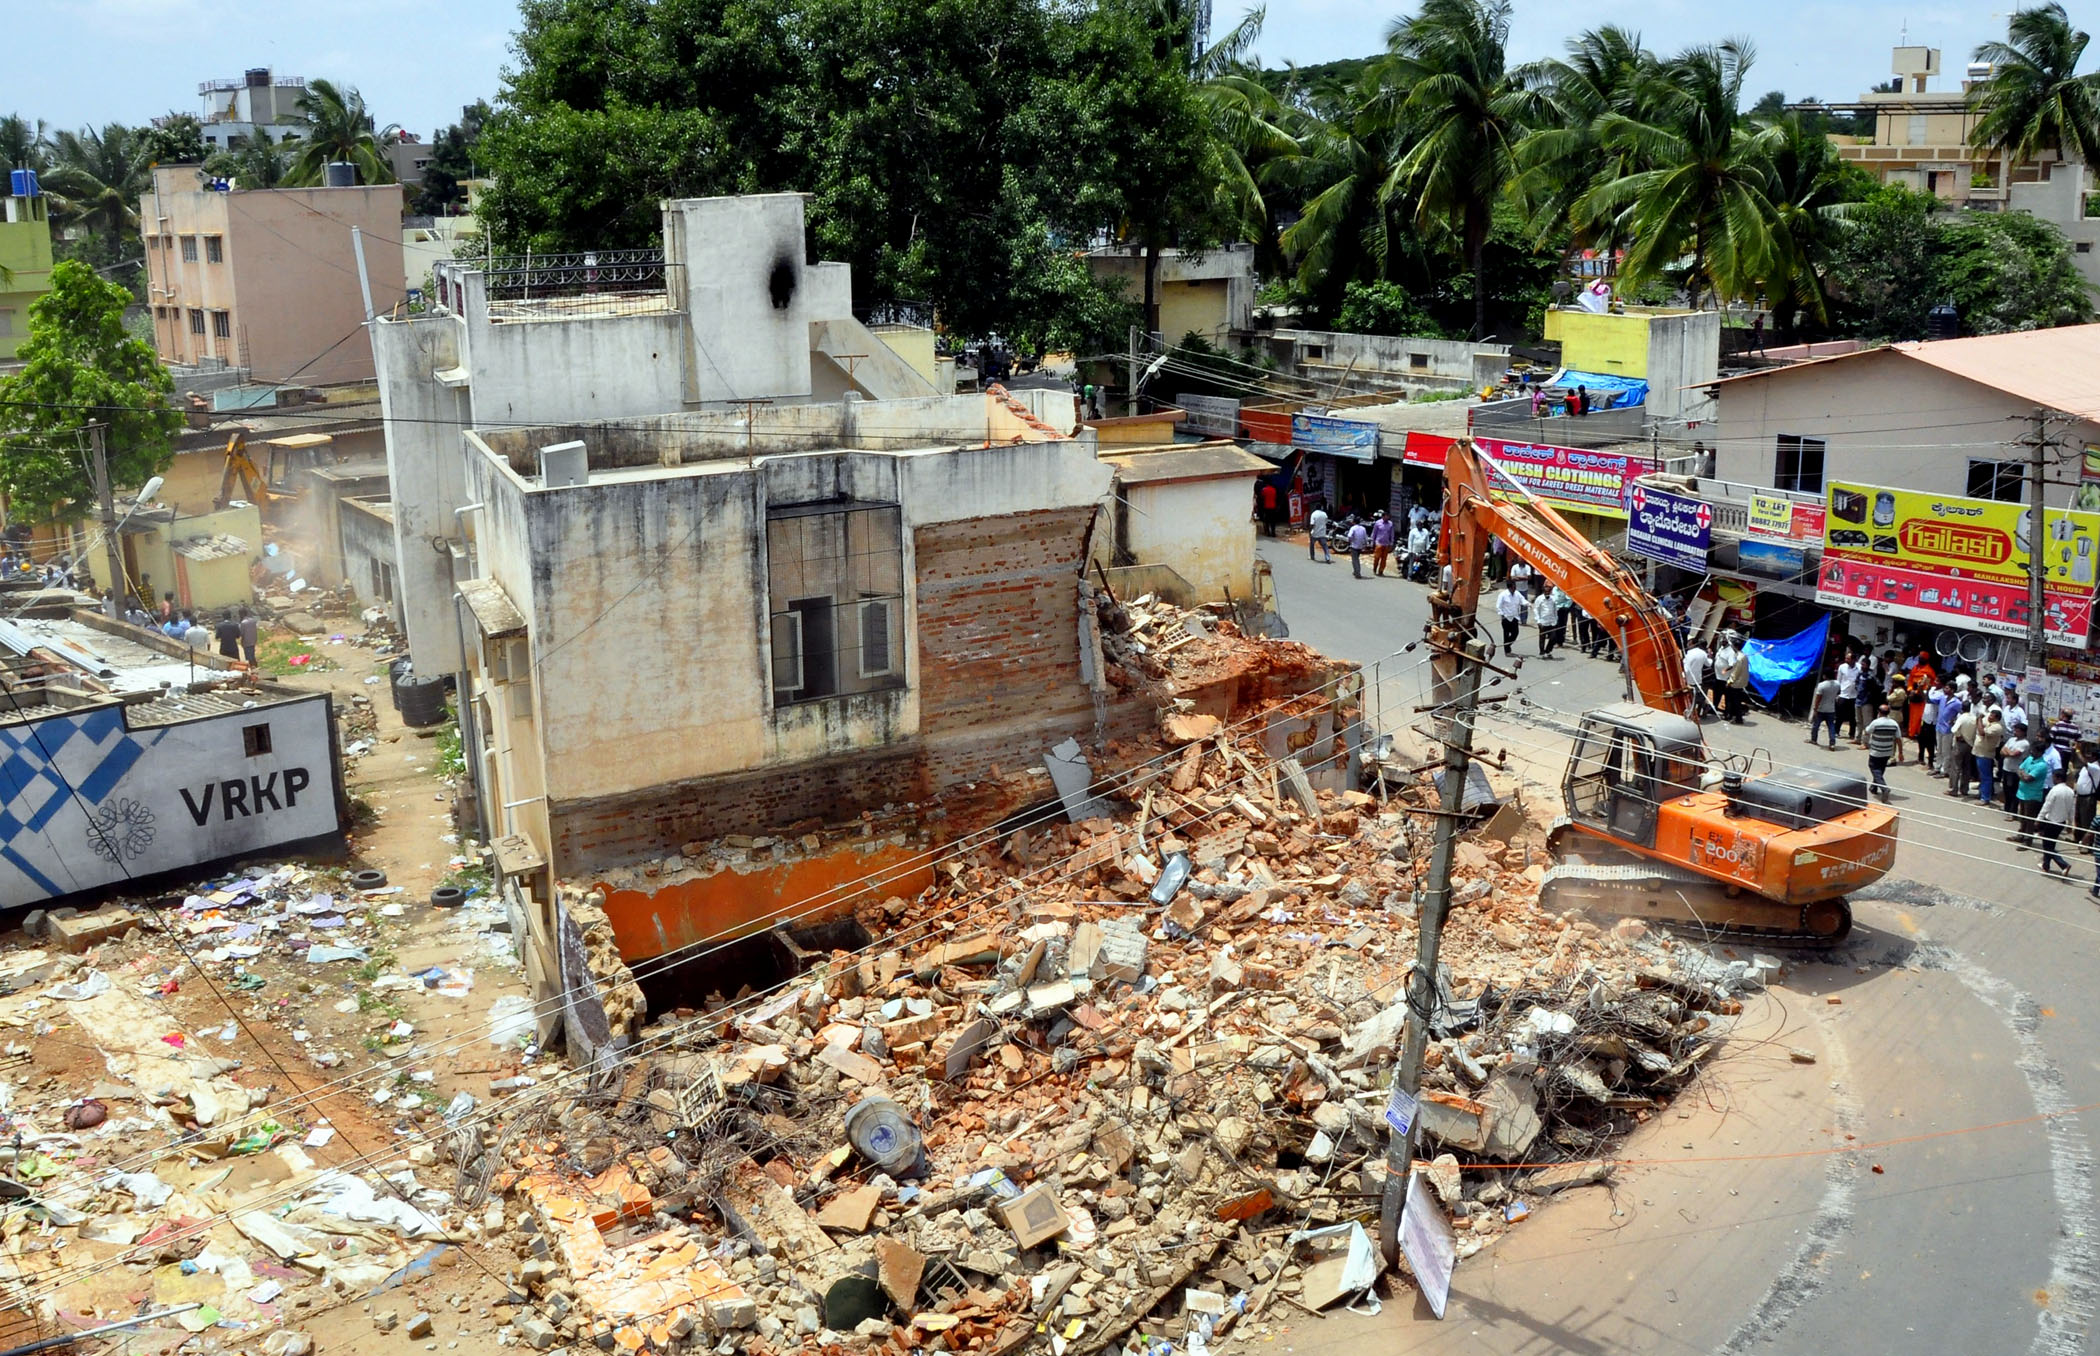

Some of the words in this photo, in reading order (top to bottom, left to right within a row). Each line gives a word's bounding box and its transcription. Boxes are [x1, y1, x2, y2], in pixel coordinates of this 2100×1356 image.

[1528, 477, 1542, 487] FOR
[1541, 478, 1564, 490] SAREES
[1564, 481, 1585, 493] DRESS
[1585, 484, 1620, 498] MATERIALS
[1545, 465, 1623, 489] CLOTHINGS
[1756, 499, 1767, 508] TO
[1773, 502, 1786, 511] LET
[1651, 535, 1674, 549] CLINICAL
[1674, 541, 1708, 559] LABORATORY
[1906, 521, 2004, 561] Kailash
[1507, 527, 1532, 553] TATA
[1531, 546, 1569, 580] HITACHI
[2056, 584, 2085, 595] HOUSE
[2051, 633, 2077, 645] HOUSE
[179, 767, 310, 827] VRKP
[1708, 831, 1724, 844] EX
[1705, 841, 1738, 863] 200
[1820, 862, 1856, 880] TATA
[1855, 843, 1890, 871] HITACHI
